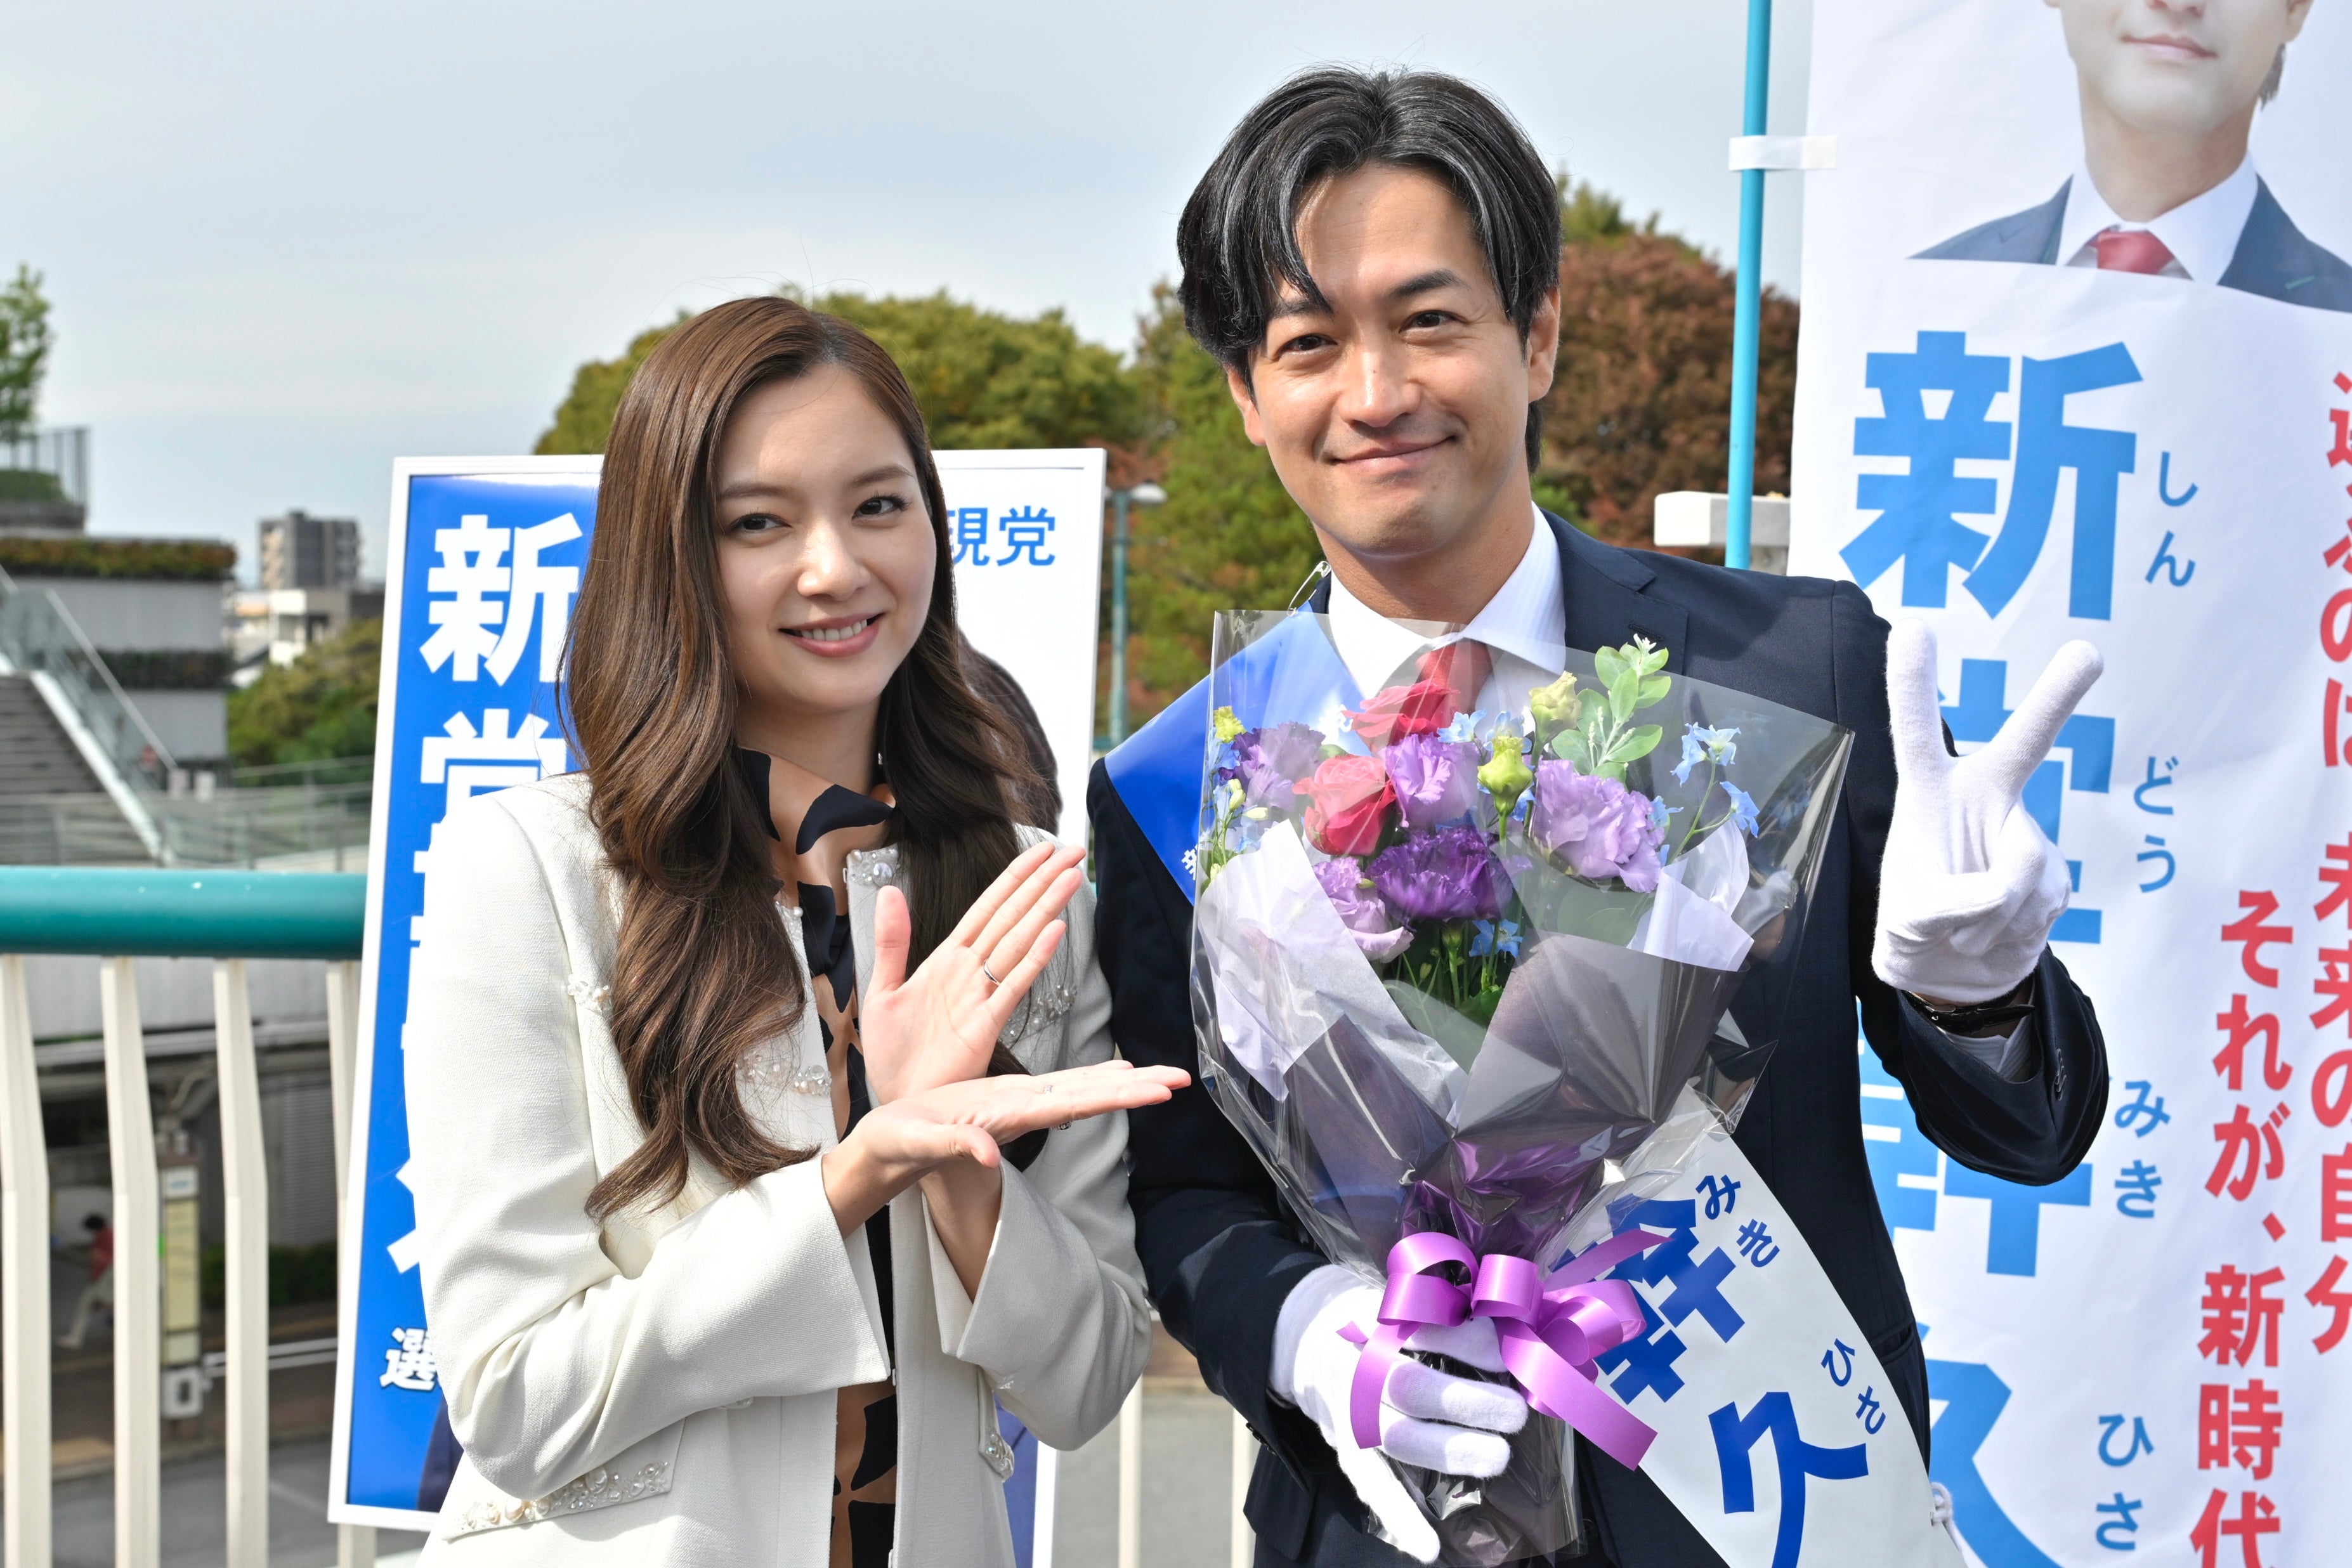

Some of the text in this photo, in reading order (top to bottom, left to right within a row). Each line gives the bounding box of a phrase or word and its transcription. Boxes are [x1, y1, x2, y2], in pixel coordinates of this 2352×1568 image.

[2095, 451, 2198, 1551] しん どう みき ひさ
[1695, 1174, 1780, 1267] みき
[1820, 1338, 1886, 1435] ひさ
